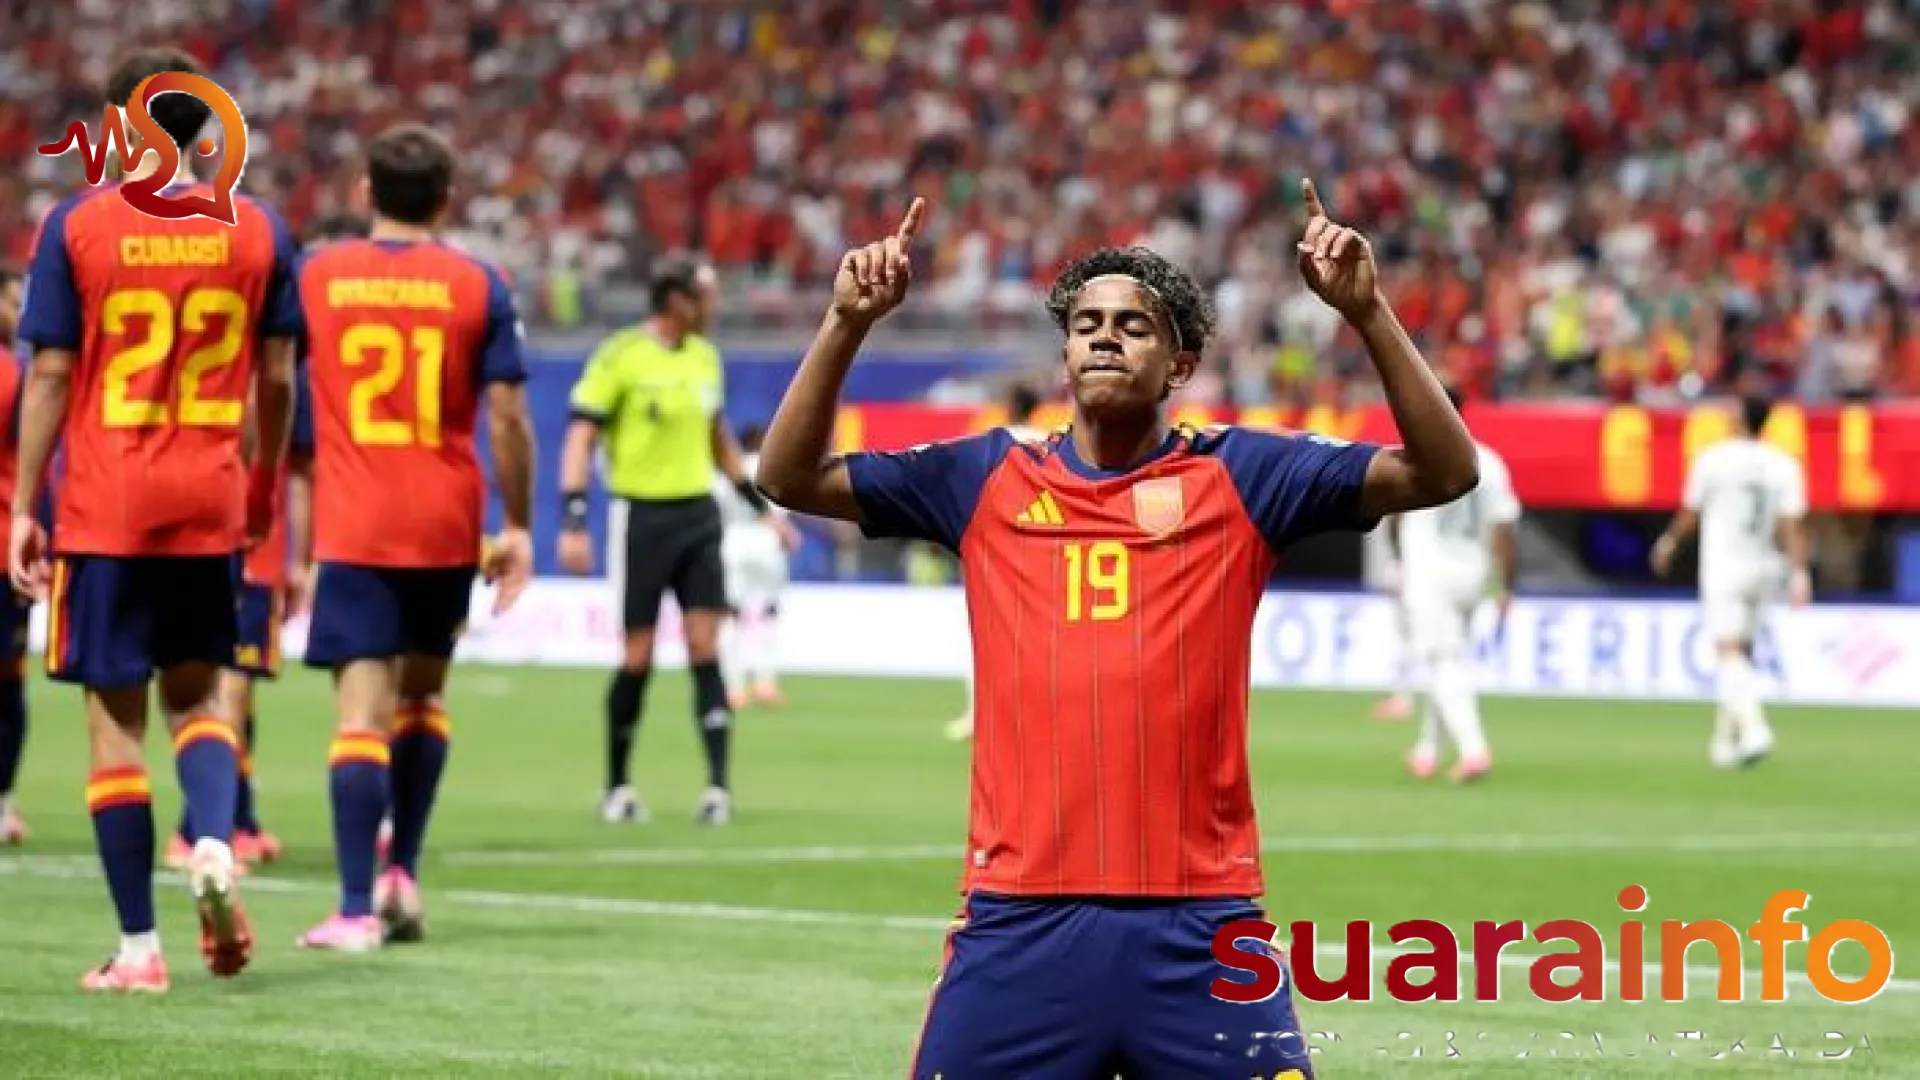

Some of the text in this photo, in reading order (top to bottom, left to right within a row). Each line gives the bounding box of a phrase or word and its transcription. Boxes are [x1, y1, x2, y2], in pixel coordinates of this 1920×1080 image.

[102, 288, 247, 428] 22
[340, 322, 444, 447] 21
[1063, 540, 1129, 621] 19
